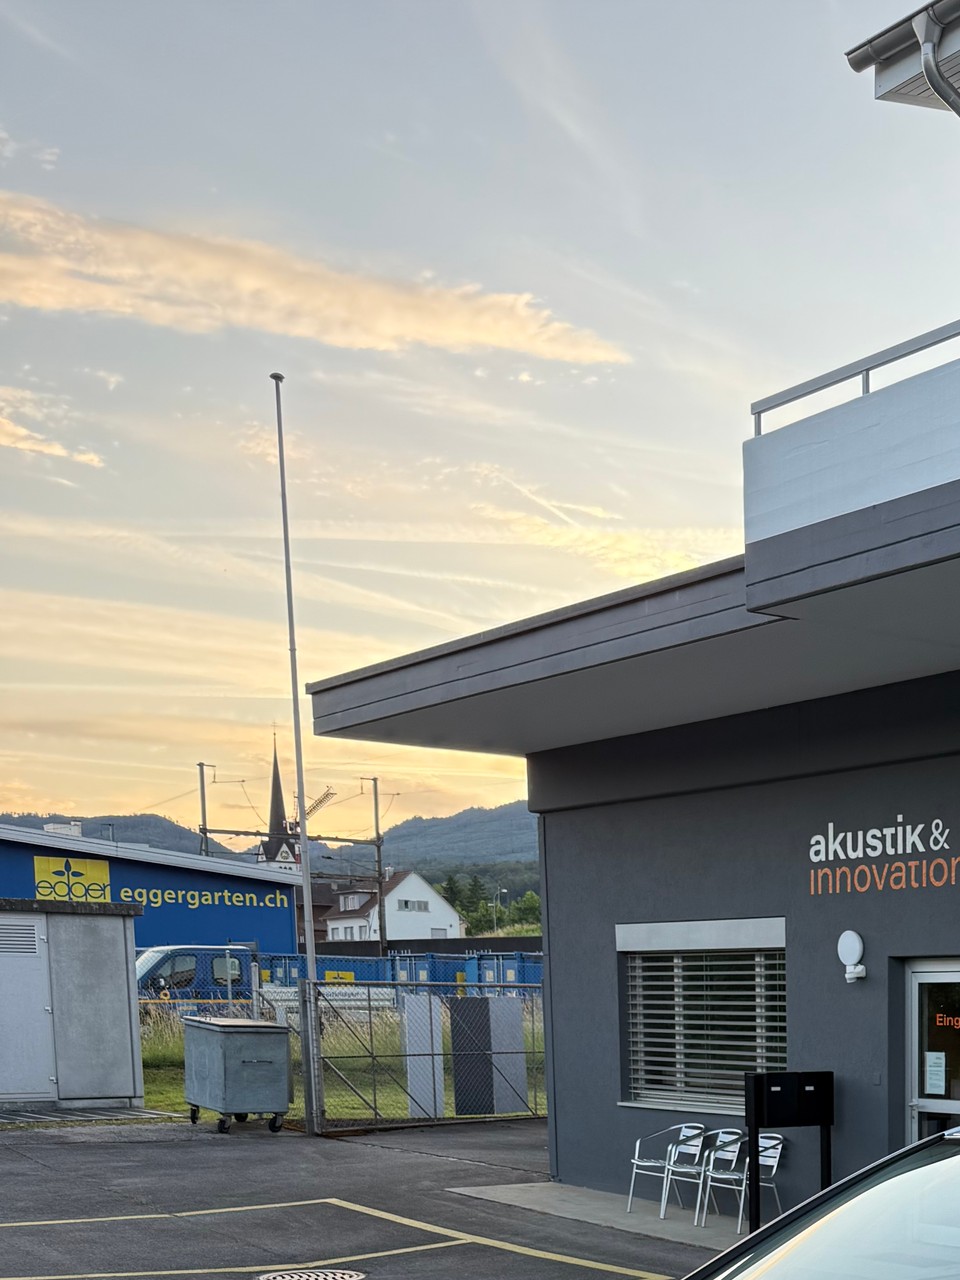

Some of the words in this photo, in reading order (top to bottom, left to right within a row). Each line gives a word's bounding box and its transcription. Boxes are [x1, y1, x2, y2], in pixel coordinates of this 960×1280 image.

[809, 814, 926, 862] akustik
[929, 818, 950, 851] &
[120, 887, 289, 908] eggergarten.ch
